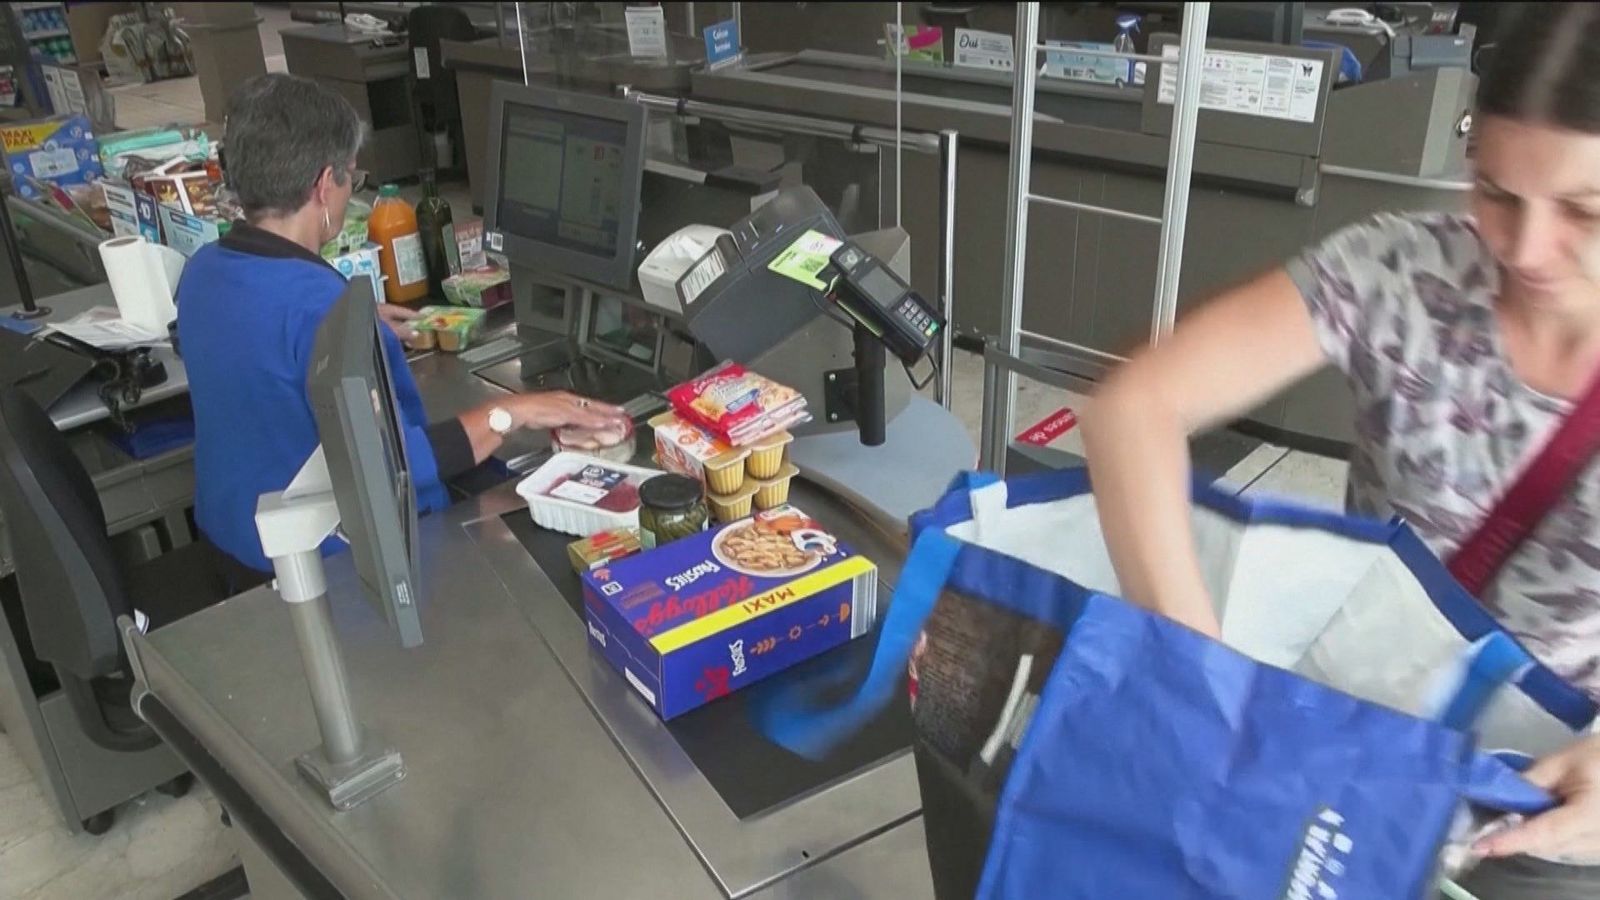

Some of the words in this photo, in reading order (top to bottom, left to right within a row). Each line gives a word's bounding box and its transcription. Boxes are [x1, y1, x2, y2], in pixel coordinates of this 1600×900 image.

[959, 34, 979, 48] Oui
[1, 128, 33, 141] MAXI
[5, 137, 36, 150] PACK
[743, 587, 795, 615] MAXI
